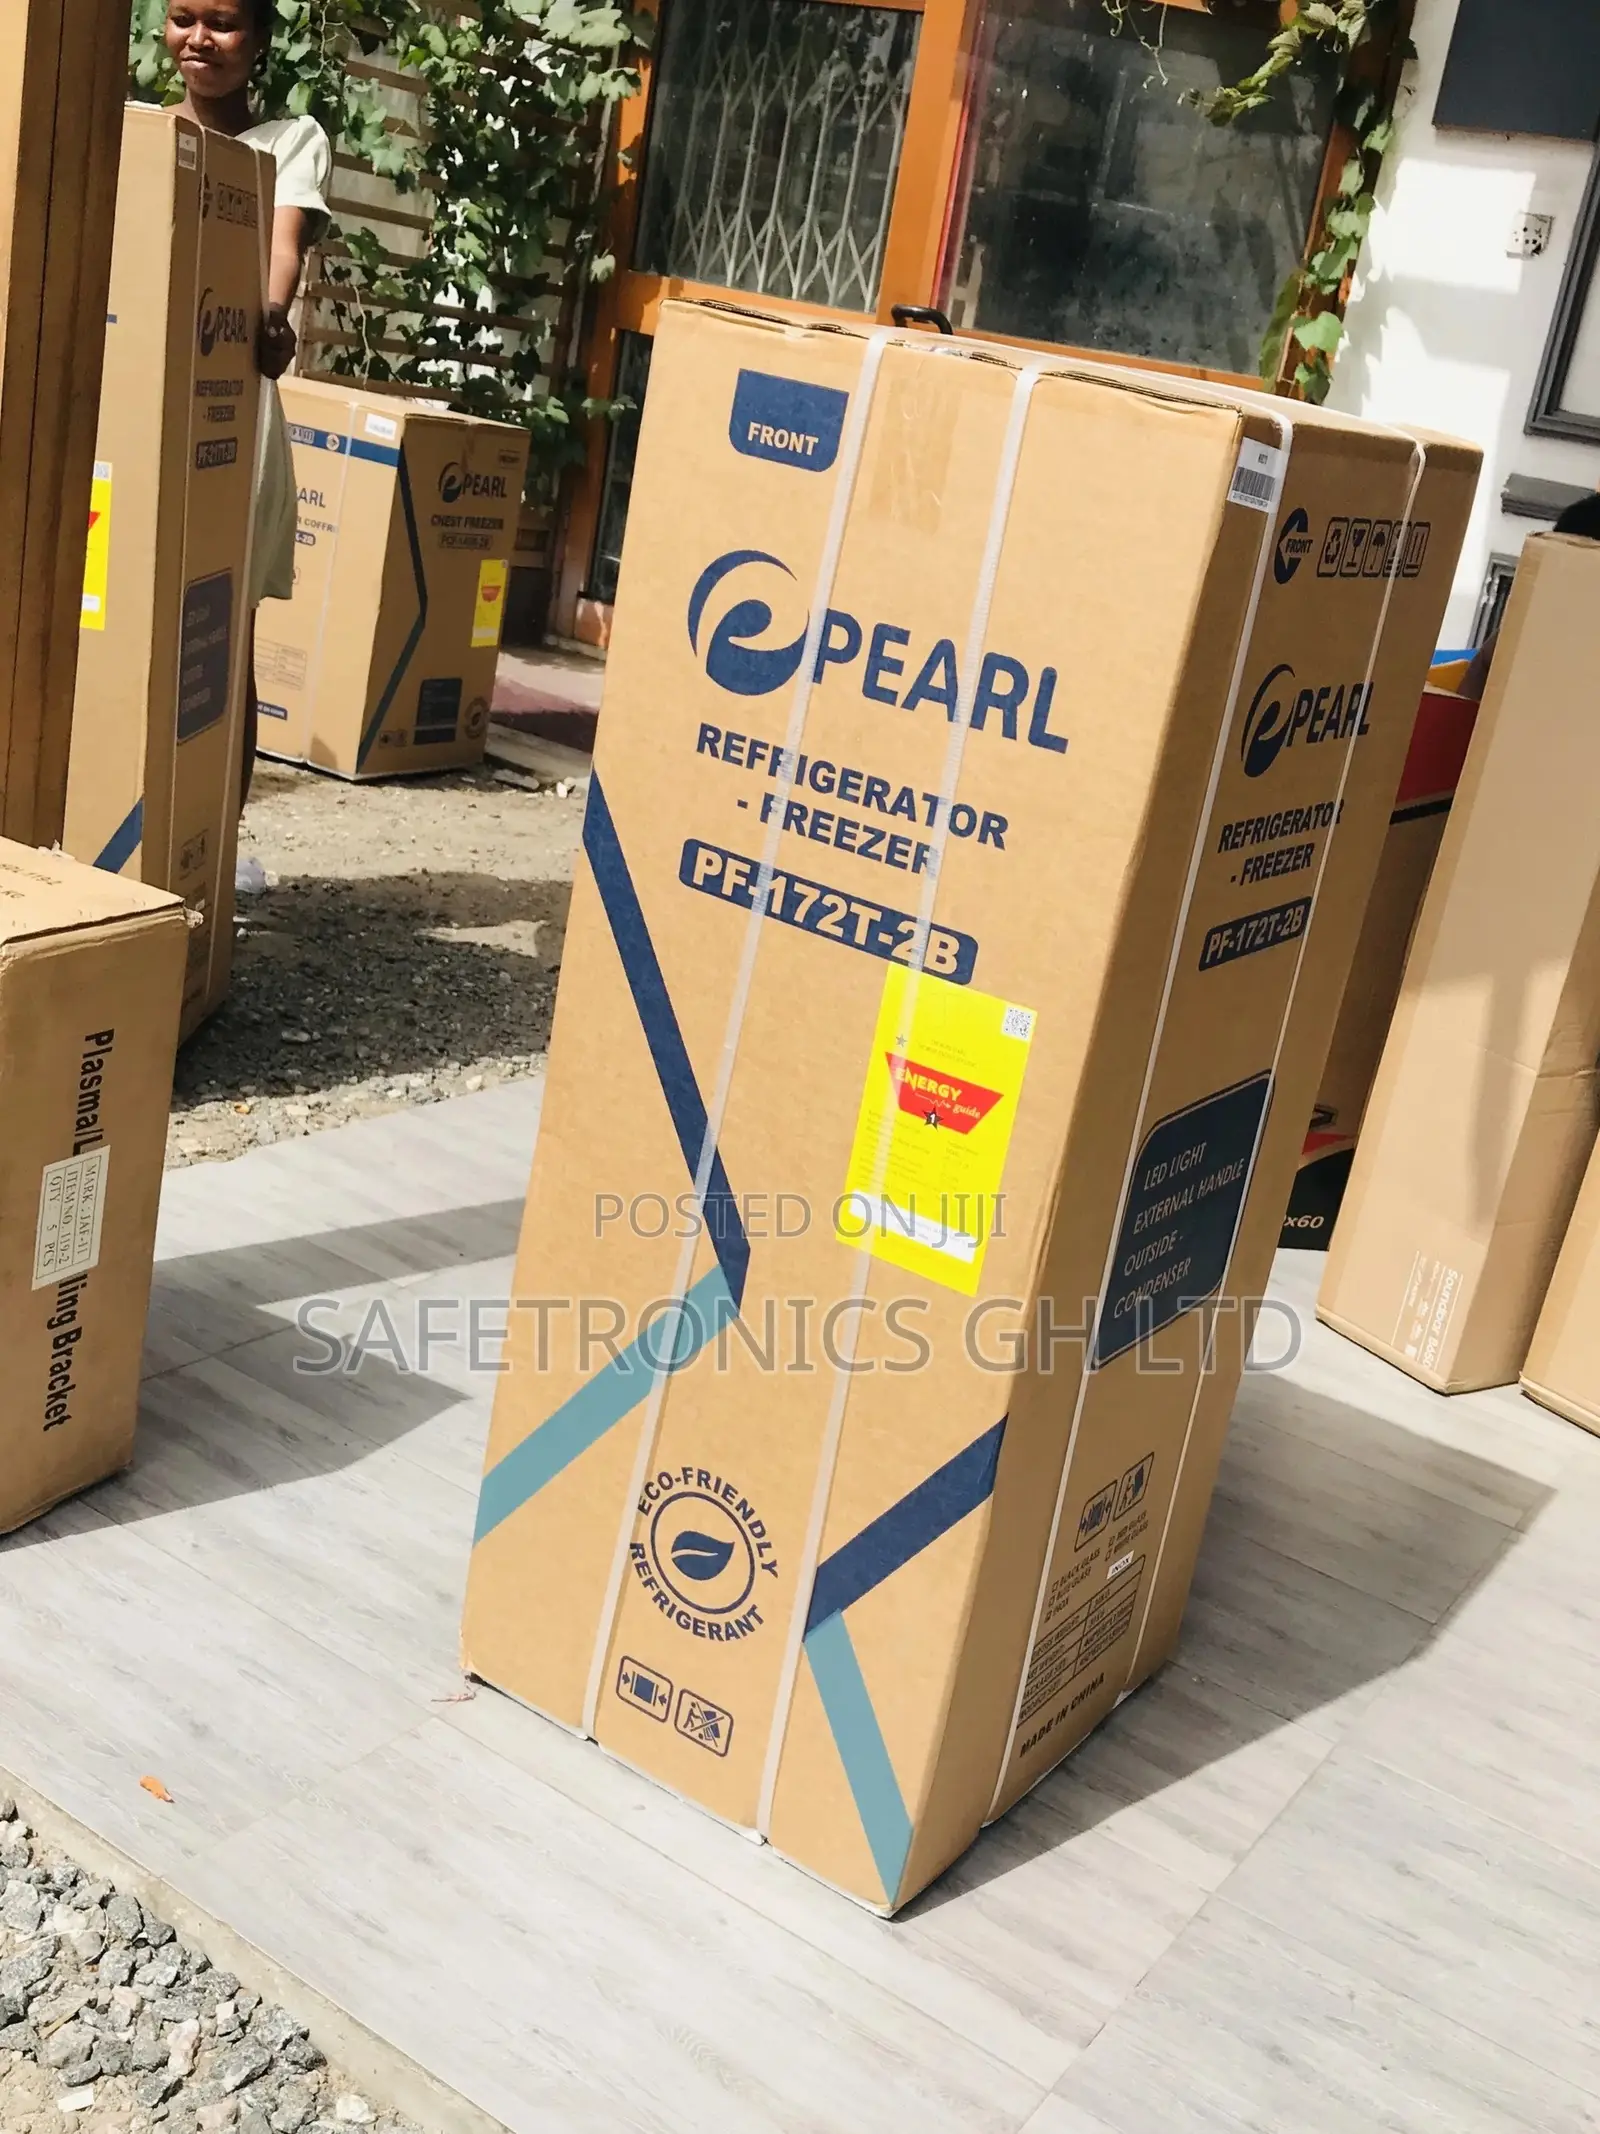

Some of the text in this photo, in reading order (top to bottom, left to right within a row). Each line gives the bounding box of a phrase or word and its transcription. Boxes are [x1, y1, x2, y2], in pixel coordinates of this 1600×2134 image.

[216, 306, 249, 344] PEARL
[747, 421, 819, 457] FRONT
[462, 473, 507, 498] PEARL
[1285, 538, 1314, 554] FRONT
[811, 607, 1069, 754] PEARL
[1286, 681, 1376, 749] PEARL
[697, 722, 1010, 850] REFRIGERATOR
[760, 793, 937, 879] FREEZER
[1218, 798, 1344, 854] REFRIGERATOR
[1239, 843, 1316, 887] FREEZER
[692, 847, 960, 976] PF-172T-2B
[1203, 904, 1307, 966] PF-172T-2B
[895, 1066, 962, 1101] ENERGY
[928, 1112, 936, 1124] 1
[953, 1103, 980, 1120] guide
[49, 1175, 62, 1202] QTY
[64, 1171, 78, 1204] ITEM
[82, 1163, 97, 1204] MARK
[1144, 1142, 1208, 1191] LED LIGHT
[1133, 1158, 1245, 1235] EXTERNAL HANDLE
[1284, 1215, 1325, 1229] x60
[43, 1242, 56, 1267] PCS
[1124, 1230, 1177, 1276] OUTSIDE
[1113, 1257, 1192, 1319] CONDENSER
[1432, 1268, 1458, 1335] Soundbar
[43, 1326, 83, 1432] Bracket
[637, 1467, 779, 1578] ECO-FRIENDLY
[630, 1541, 766, 1642] REFRIGERANT
[1020, 1717, 1052, 1758] MADE
[1054, 1705, 1068, 1726] IN
[1070, 1672, 1105, 1711] CHINA
